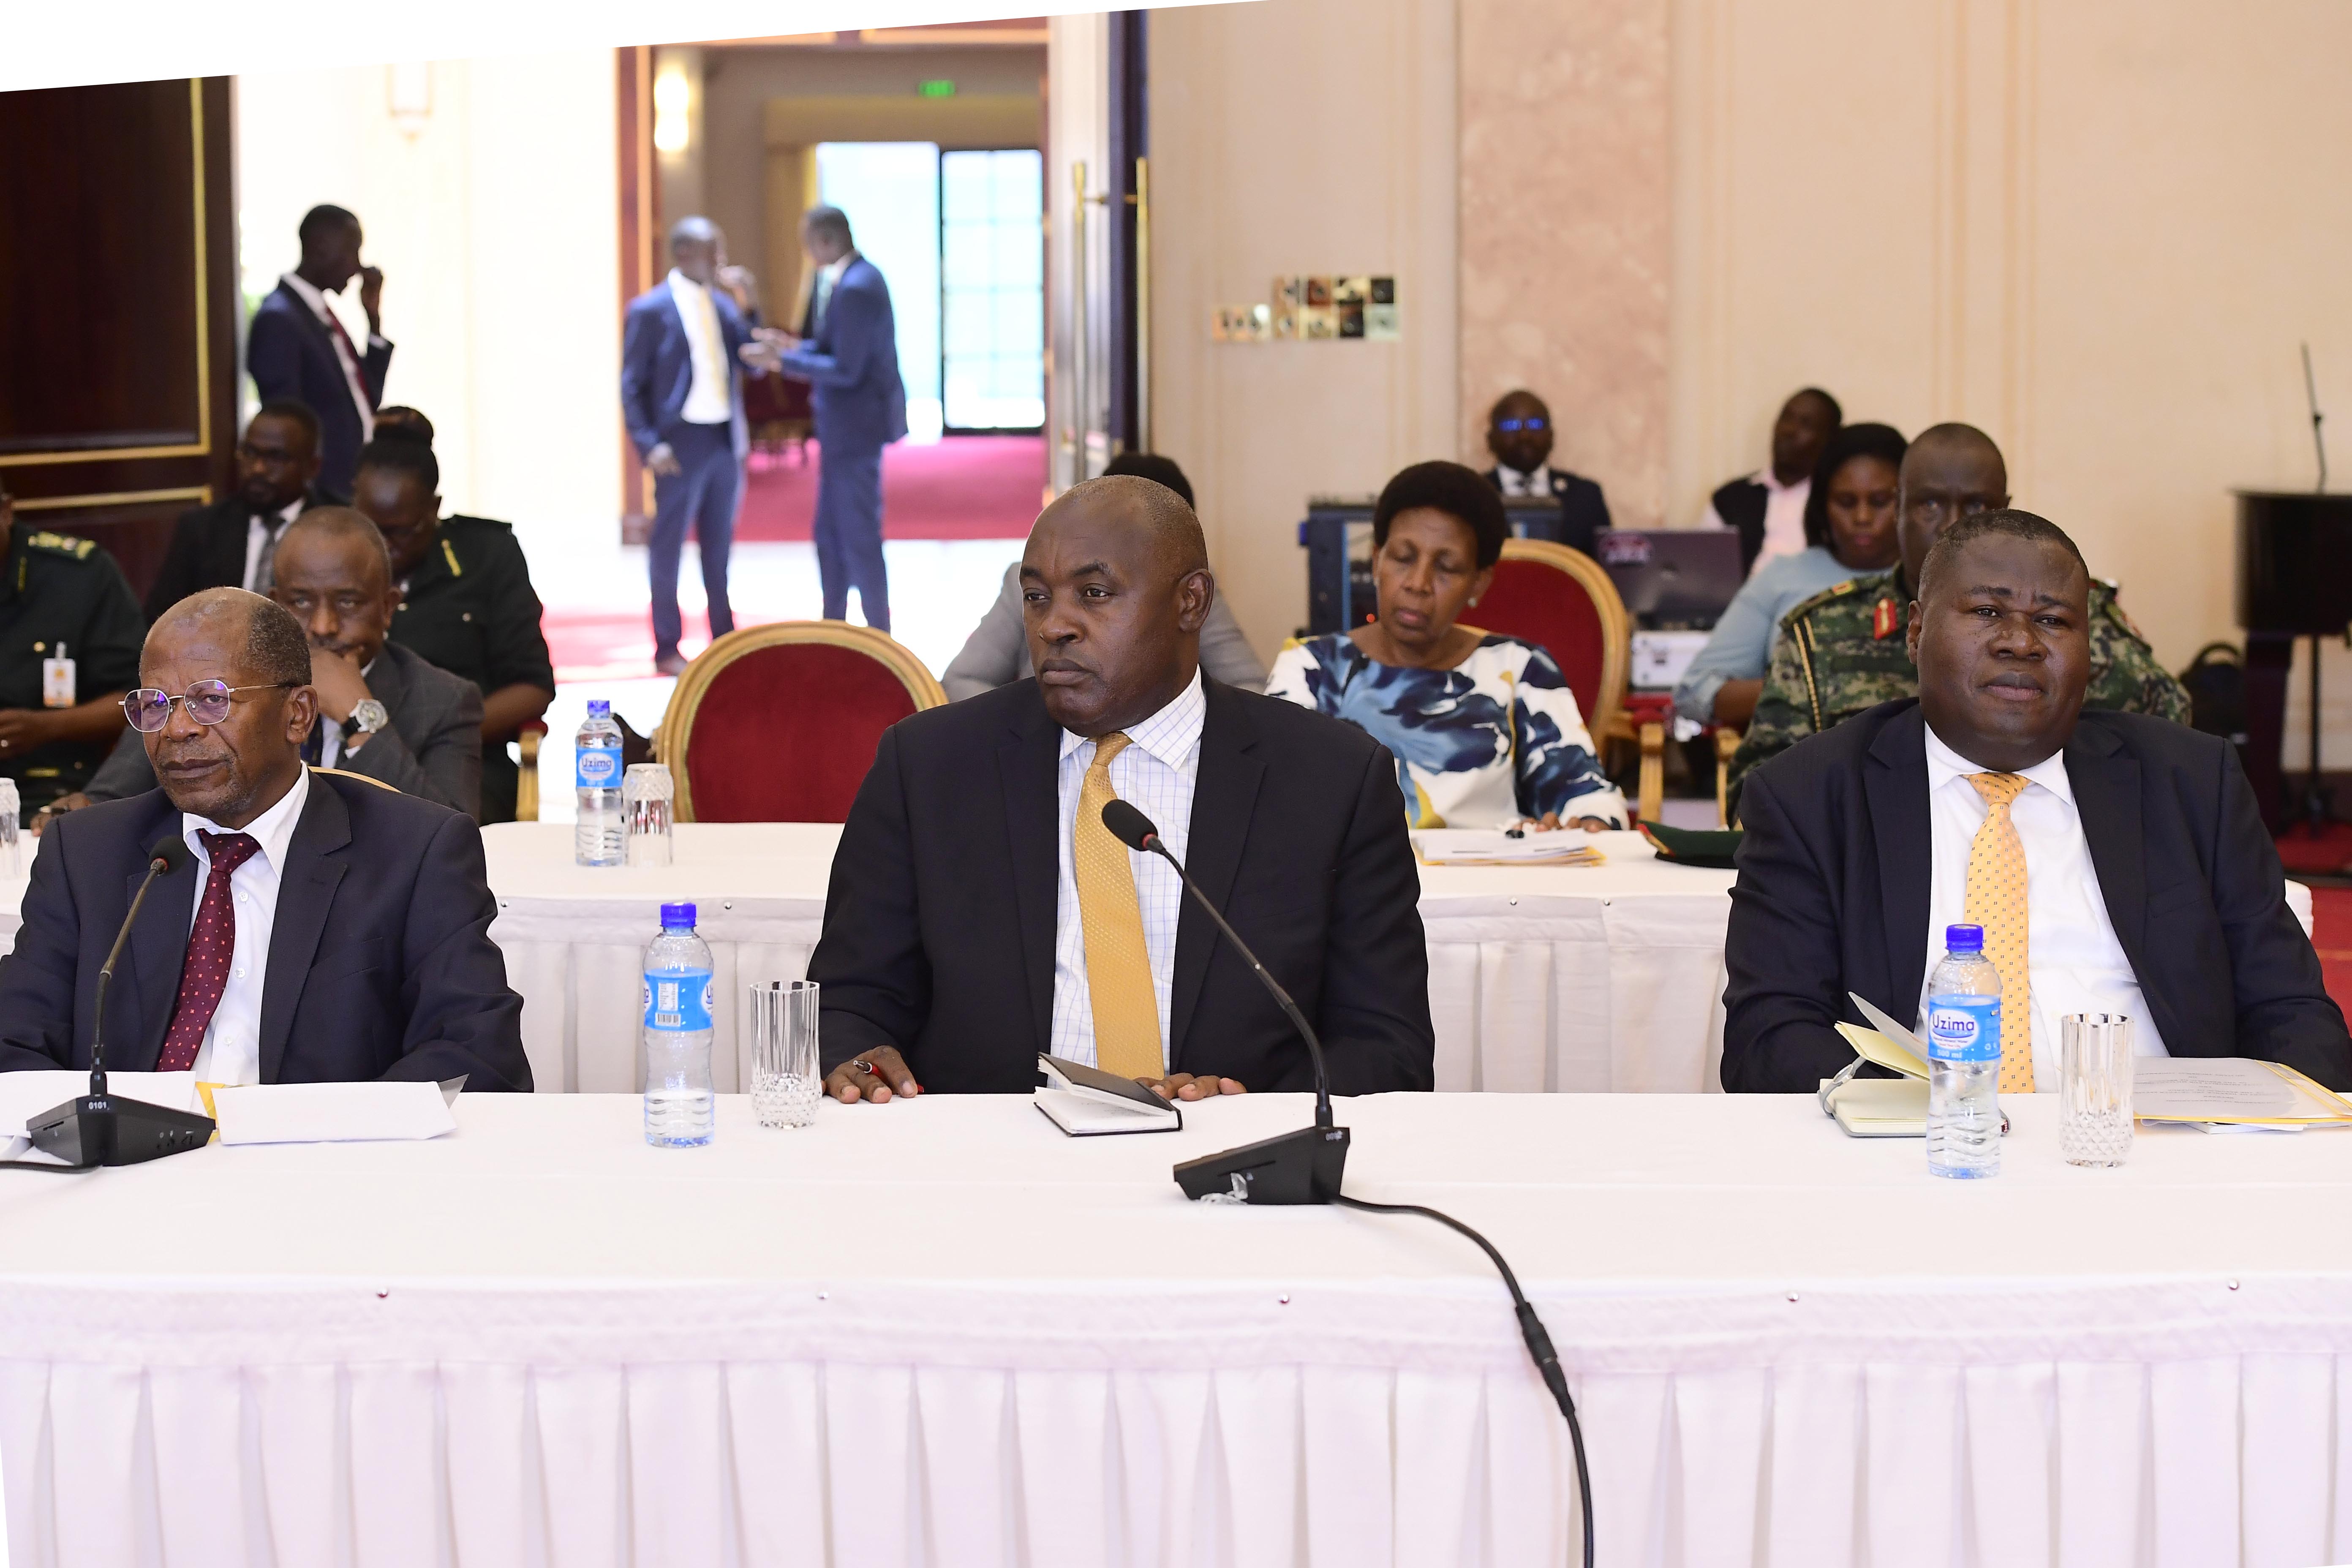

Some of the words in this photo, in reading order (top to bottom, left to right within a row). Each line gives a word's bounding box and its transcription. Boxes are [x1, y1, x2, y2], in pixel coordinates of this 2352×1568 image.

[582, 757, 612, 767] Uzima
[1933, 1013, 1974, 1031] Uzima
[88, 1101, 106, 1110] 0101
